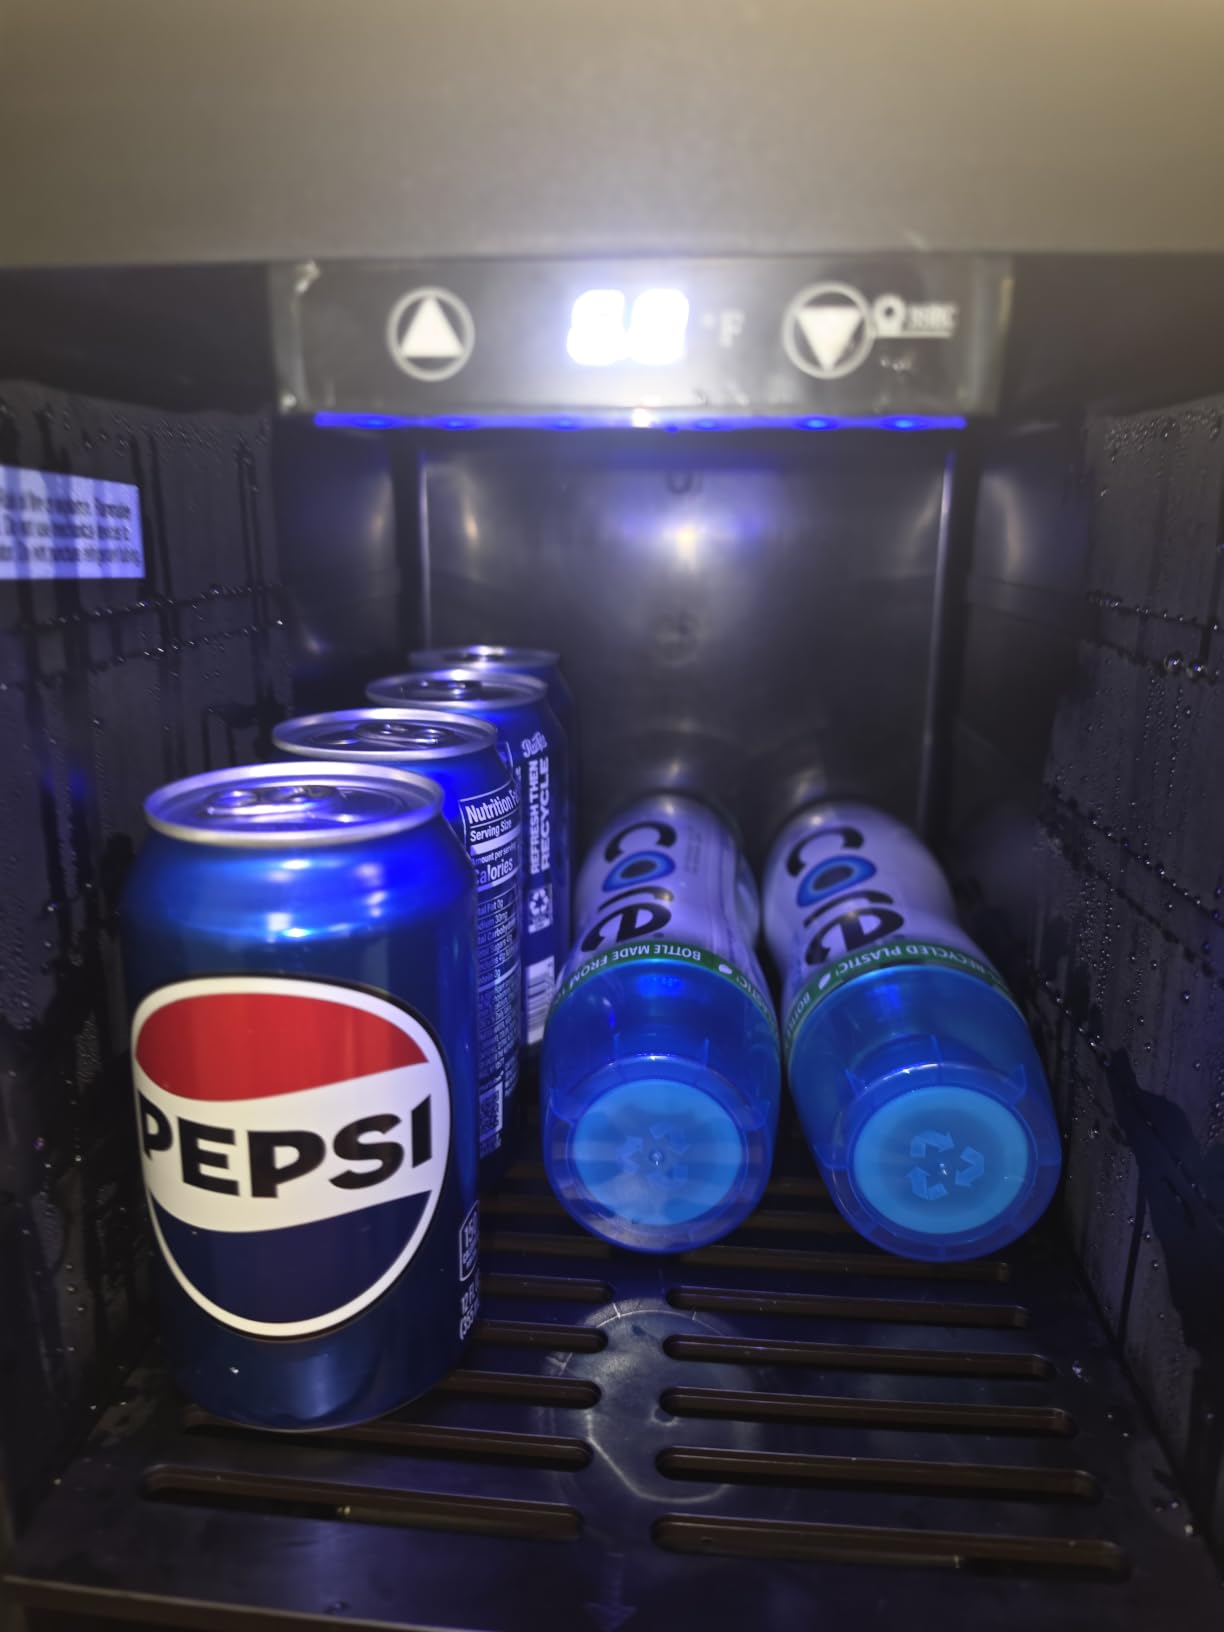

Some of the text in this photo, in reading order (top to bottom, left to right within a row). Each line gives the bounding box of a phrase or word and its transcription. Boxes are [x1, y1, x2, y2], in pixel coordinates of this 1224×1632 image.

[465, 792, 512, 824] Nutrition
[470, 818, 512, 842] Serving Size
[529, 759, 540, 875] REFRESH THEN
[539, 756, 550, 871] RECYCLE
[569, 943, 701, 988] BOTTLE MADE FROM
[137, 1090, 433, 1199] PEPSI
